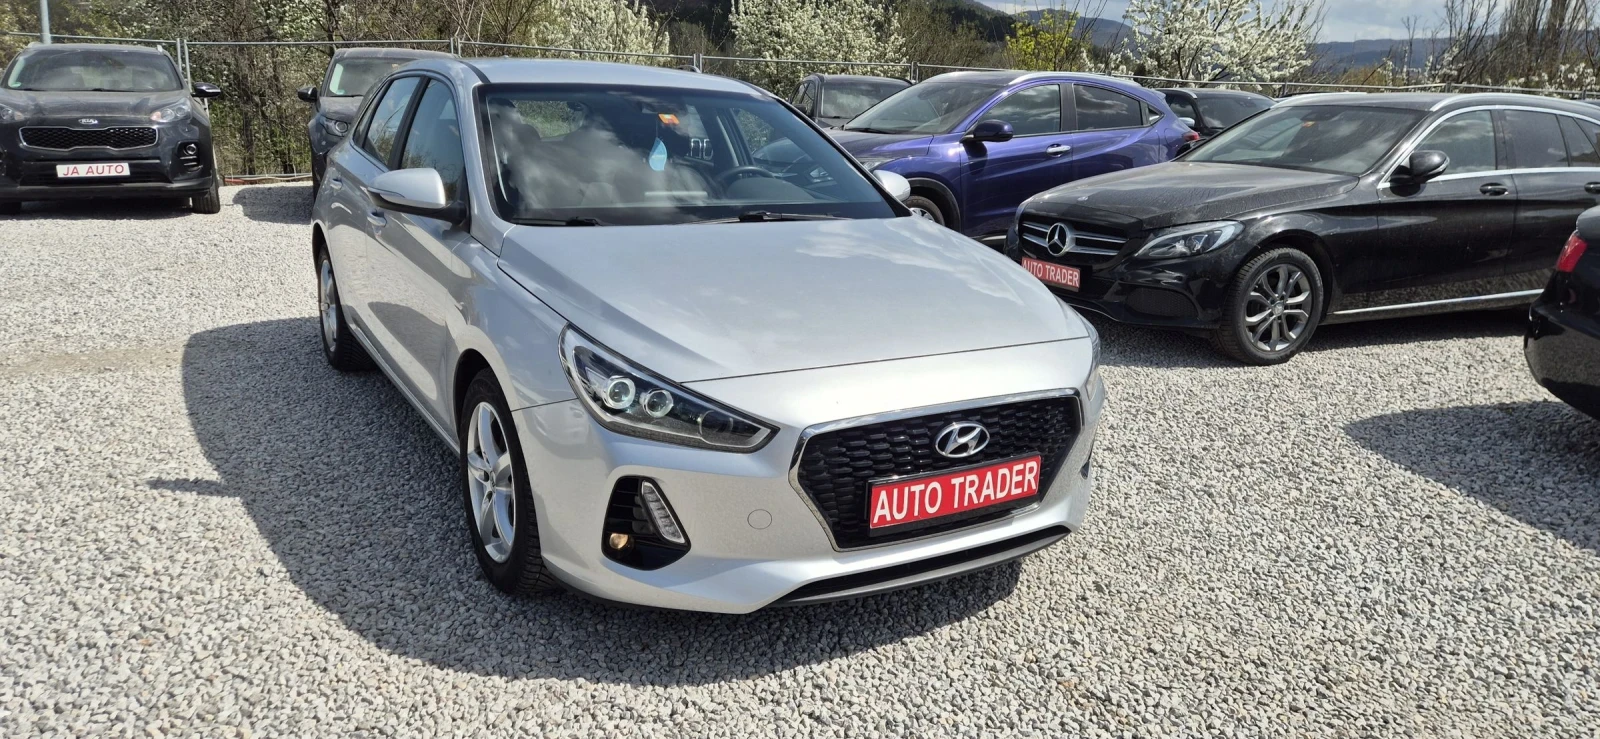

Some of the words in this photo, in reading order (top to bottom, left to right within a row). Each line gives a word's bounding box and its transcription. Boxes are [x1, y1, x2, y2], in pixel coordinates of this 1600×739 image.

[63, 166, 80, 176] JA
[85, 164, 125, 175] AUTO
[1022, 259, 1044, 278] AUTO
[1045, 265, 1080, 288] TRADER
[872, 481, 943, 524] AUTO
[950, 460, 1039, 509] TRADER
